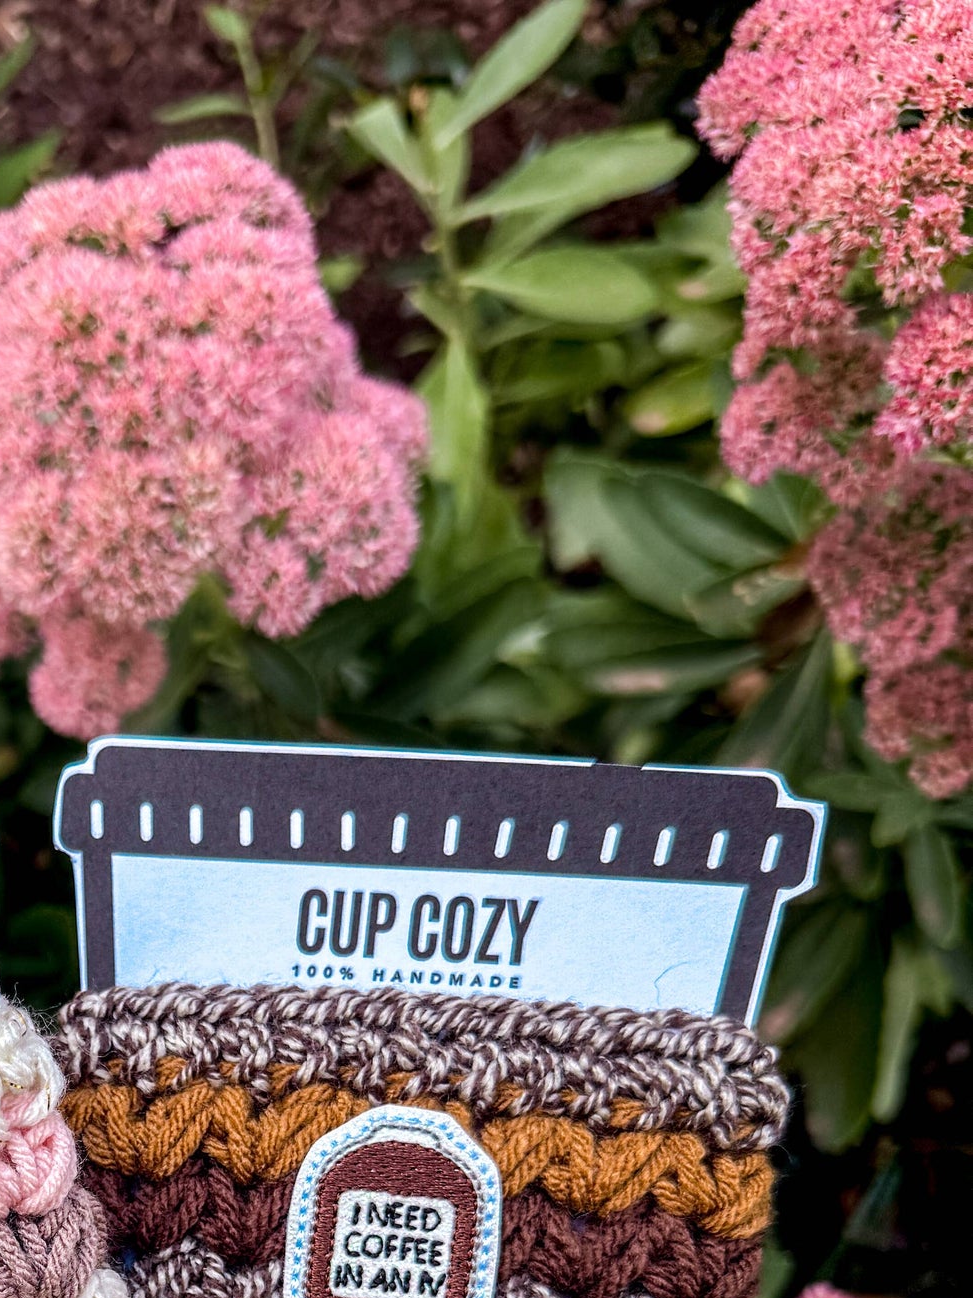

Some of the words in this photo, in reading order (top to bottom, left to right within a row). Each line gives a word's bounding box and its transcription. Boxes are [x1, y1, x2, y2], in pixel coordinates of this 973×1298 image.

[296, 888, 397, 958] CUP
[407, 894, 540, 967] COZY
[292, 963, 354, 980] 100%
[372, 968, 522, 989] HANDMADE
[352, 1202, 361, 1225] I
[367, 1202, 441, 1232] NEED
[344, 1231, 443, 1267] COFFEE
[333, 1264, 363, 1288] IN
[368, 1268, 411, 1293] AN
